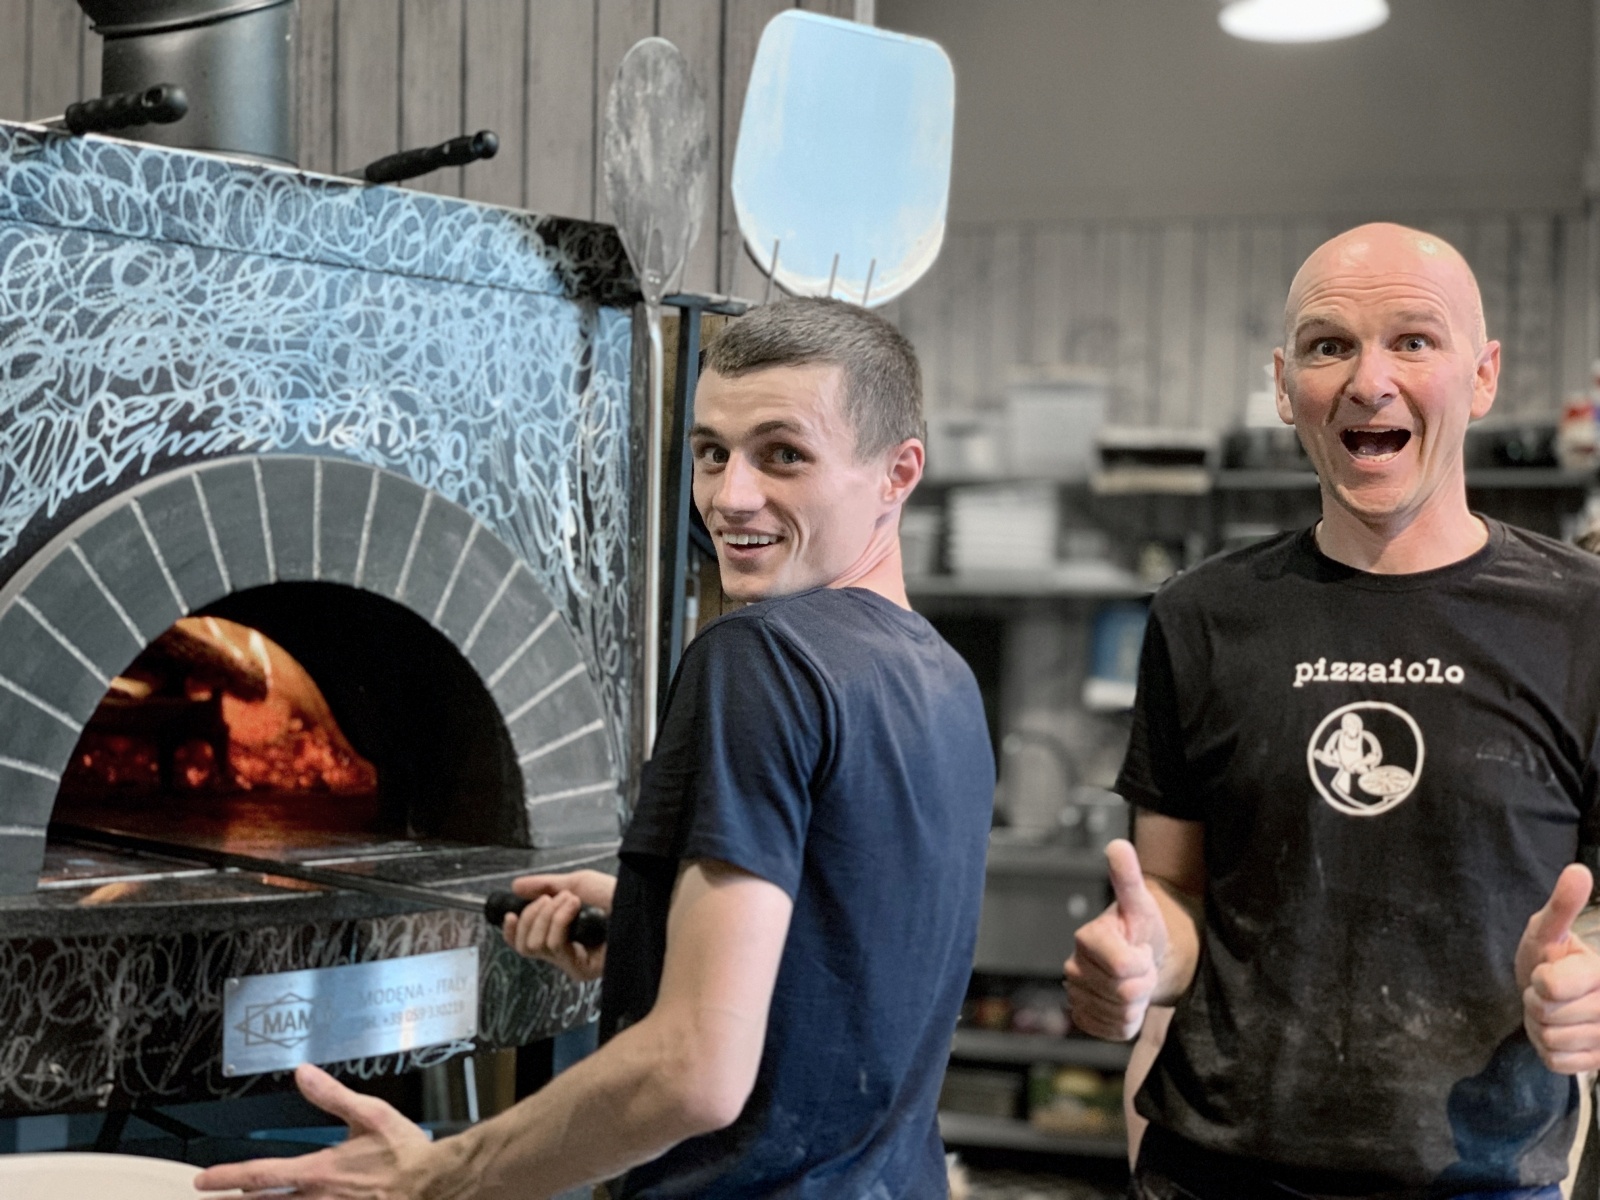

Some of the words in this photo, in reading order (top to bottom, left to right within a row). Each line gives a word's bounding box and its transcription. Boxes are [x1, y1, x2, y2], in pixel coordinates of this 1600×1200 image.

[1293, 657, 1465, 688] pizzaiolo
[358, 982, 425, 1006] MODENA
[436, 975, 468, 995] ITALY
